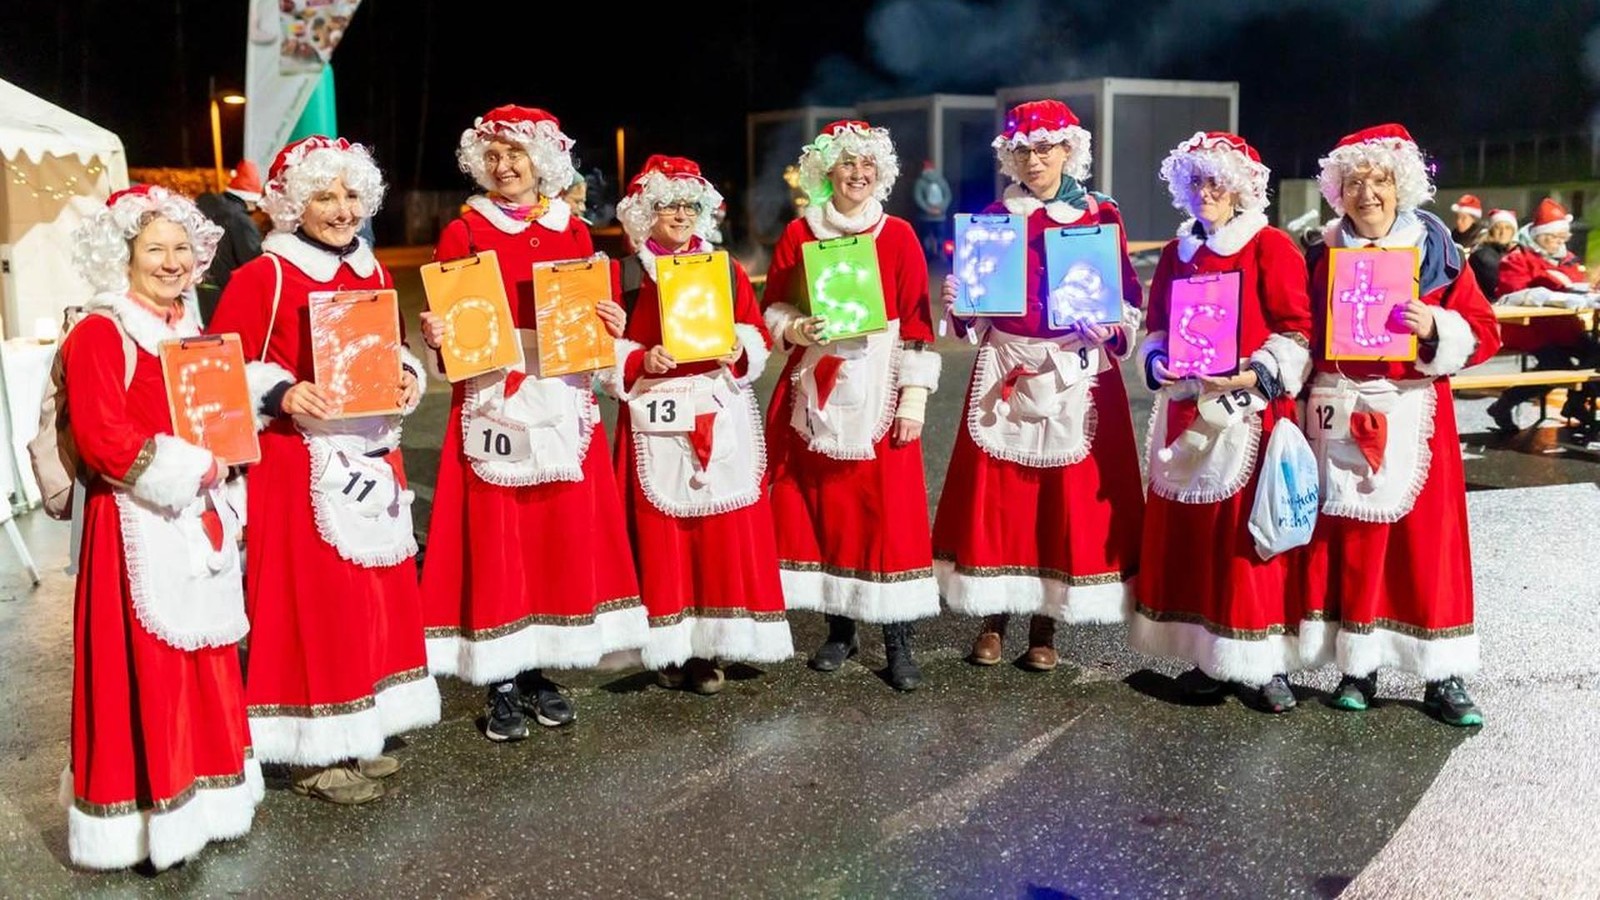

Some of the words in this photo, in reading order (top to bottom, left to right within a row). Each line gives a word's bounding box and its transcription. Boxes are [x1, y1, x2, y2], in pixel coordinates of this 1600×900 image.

[959, 228, 1017, 307] F
[549, 275, 600, 363] h
[1339, 259, 1393, 347] t
[325, 329, 382, 407] r
[179, 358, 232, 449] F
[646, 399, 677, 423] 13
[1216, 388, 1252, 415] 15
[1316, 404, 1335, 429] 12
[482, 428, 511, 456] 10
[342, 471, 377, 503] 11
